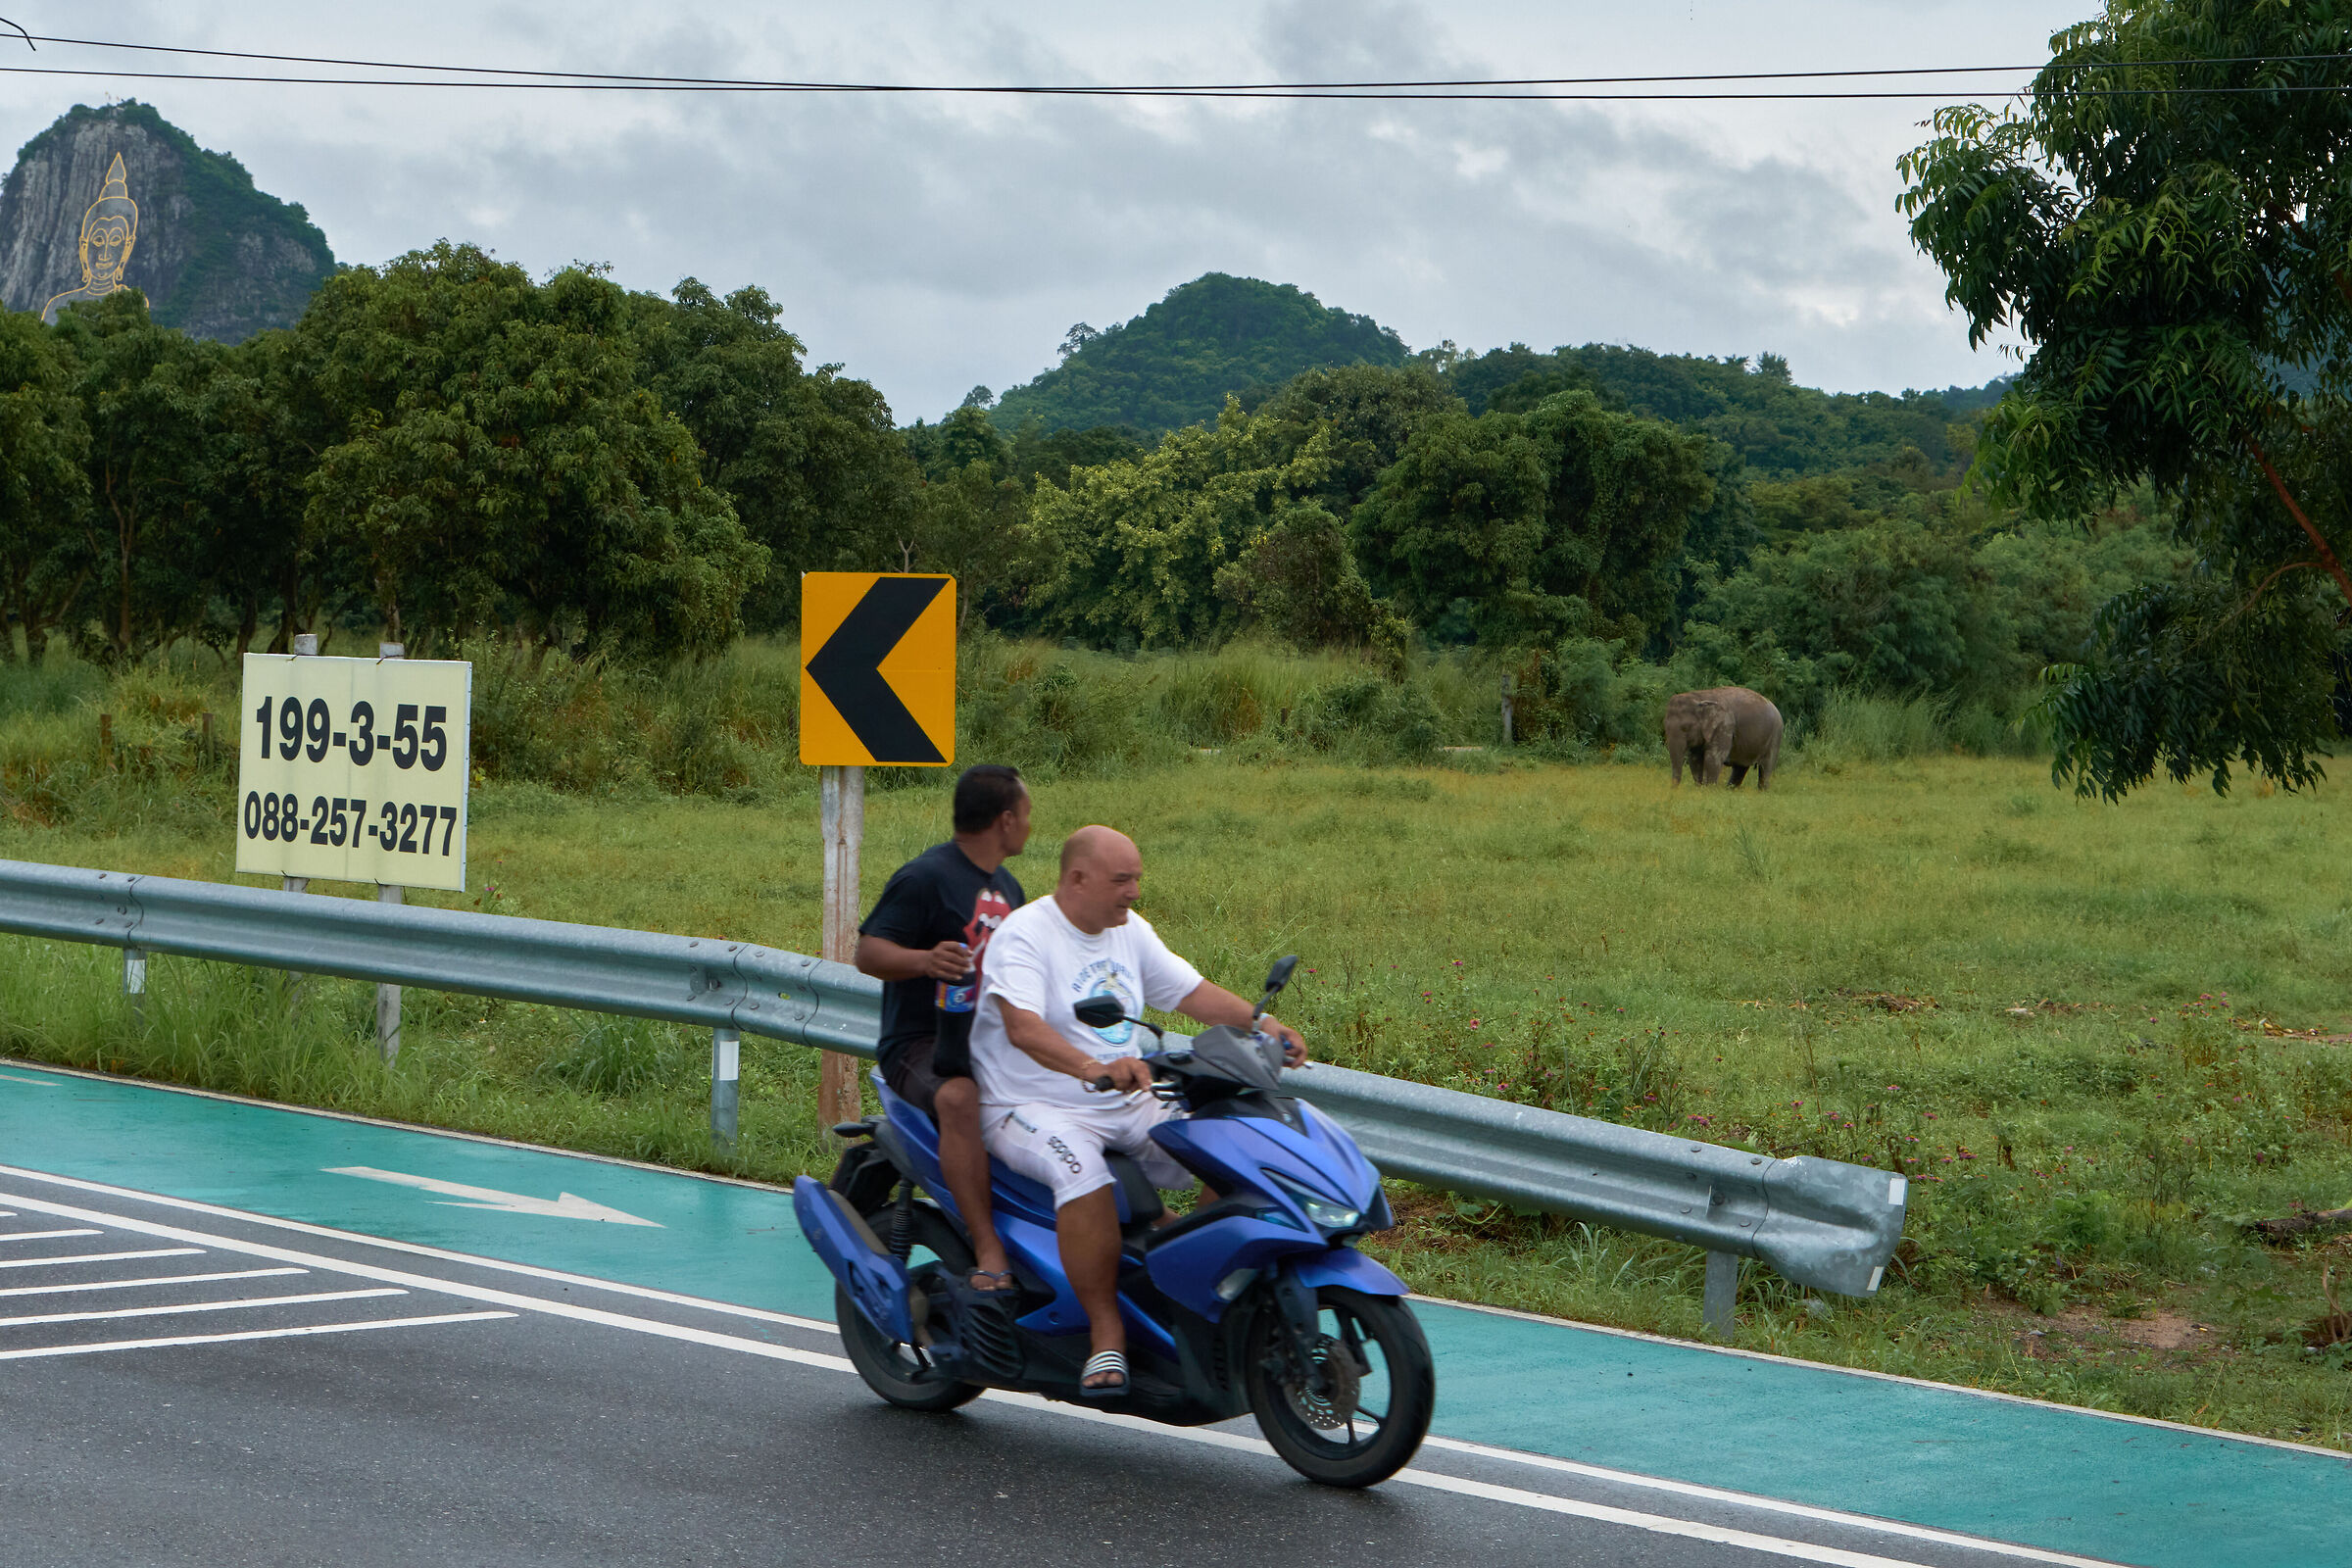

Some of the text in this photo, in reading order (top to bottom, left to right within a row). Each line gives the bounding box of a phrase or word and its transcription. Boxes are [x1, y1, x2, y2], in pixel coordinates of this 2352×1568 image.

[256, 696, 447, 772] 199-3-55
[244, 790, 458, 857] 088-257-3277
[1047, 1135, 1083, 1174] adidas
